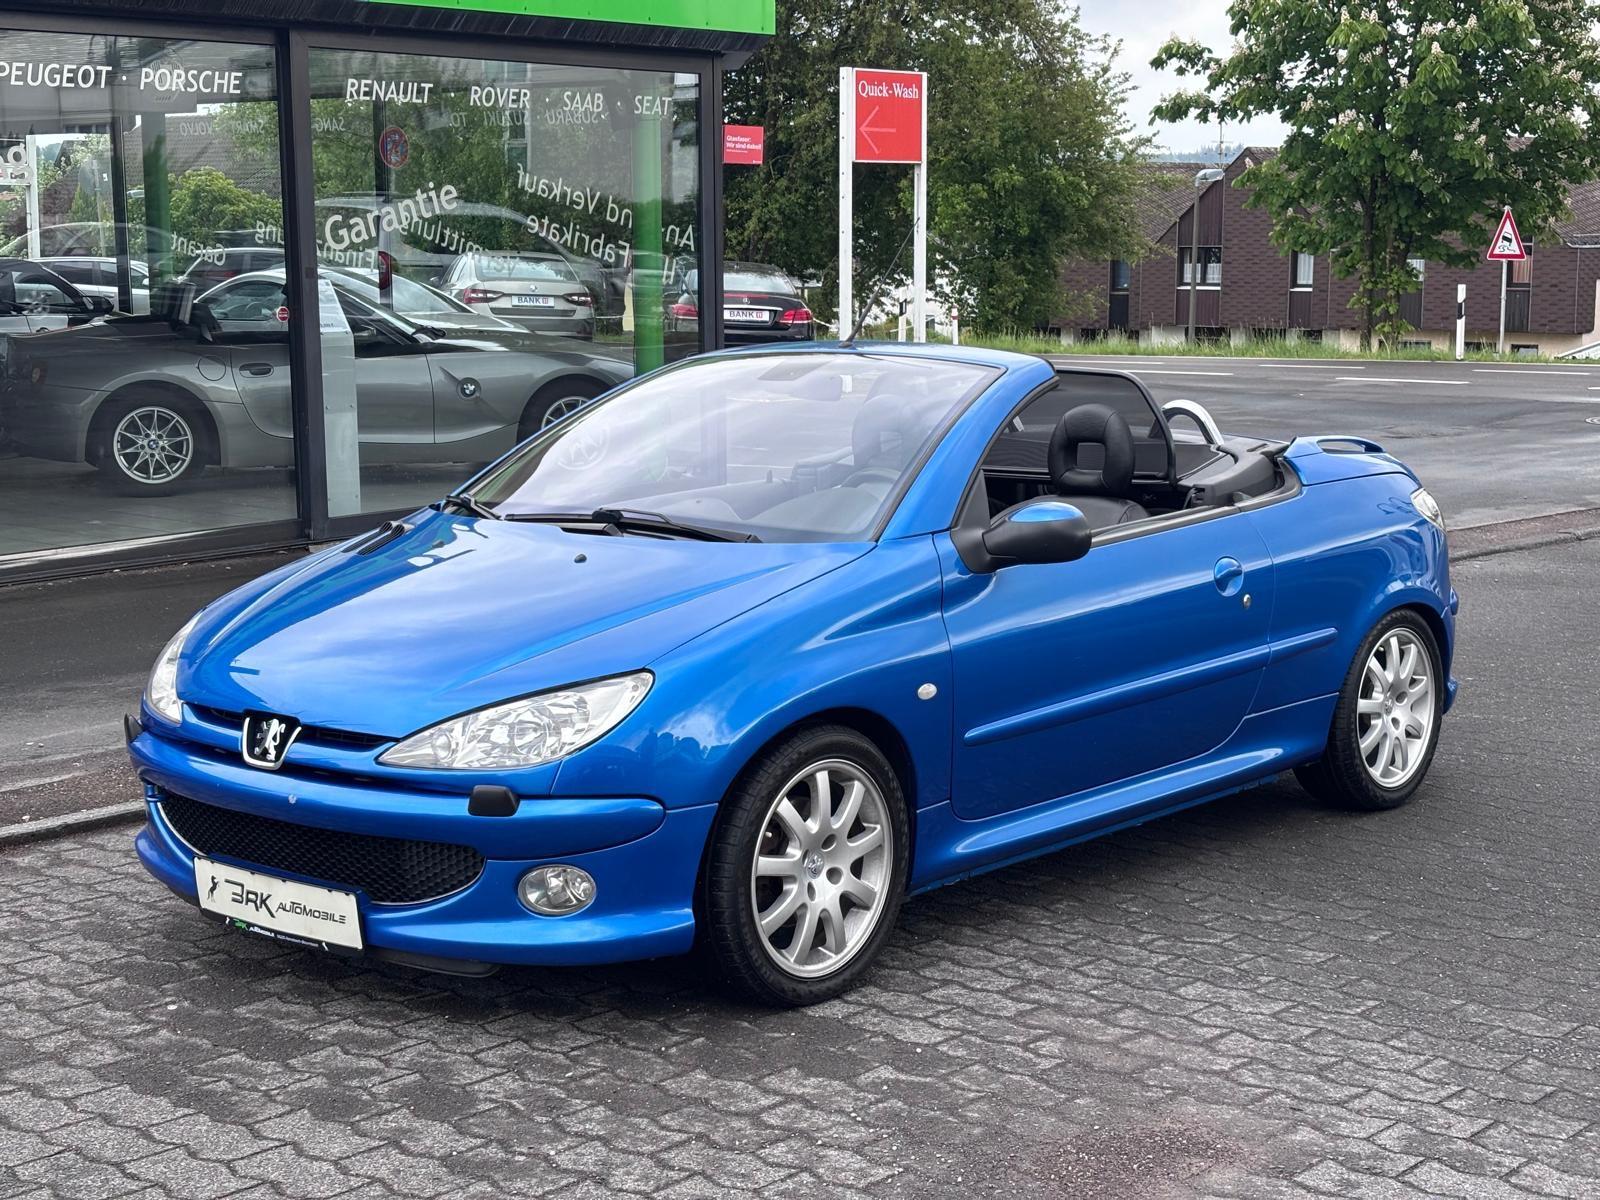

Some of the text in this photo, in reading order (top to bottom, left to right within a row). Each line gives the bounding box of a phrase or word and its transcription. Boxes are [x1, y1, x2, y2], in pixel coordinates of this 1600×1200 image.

[0, 61, 243, 94] PEUGEOT PORSCHE
[858, 80, 919, 99] Quick-Wash
[346, 78, 673, 116] RENAULT ROVER SAAB SEAT
[324, 181, 459, 250] Garantie
[275, 901, 347, 925] AUTOMOBILE
